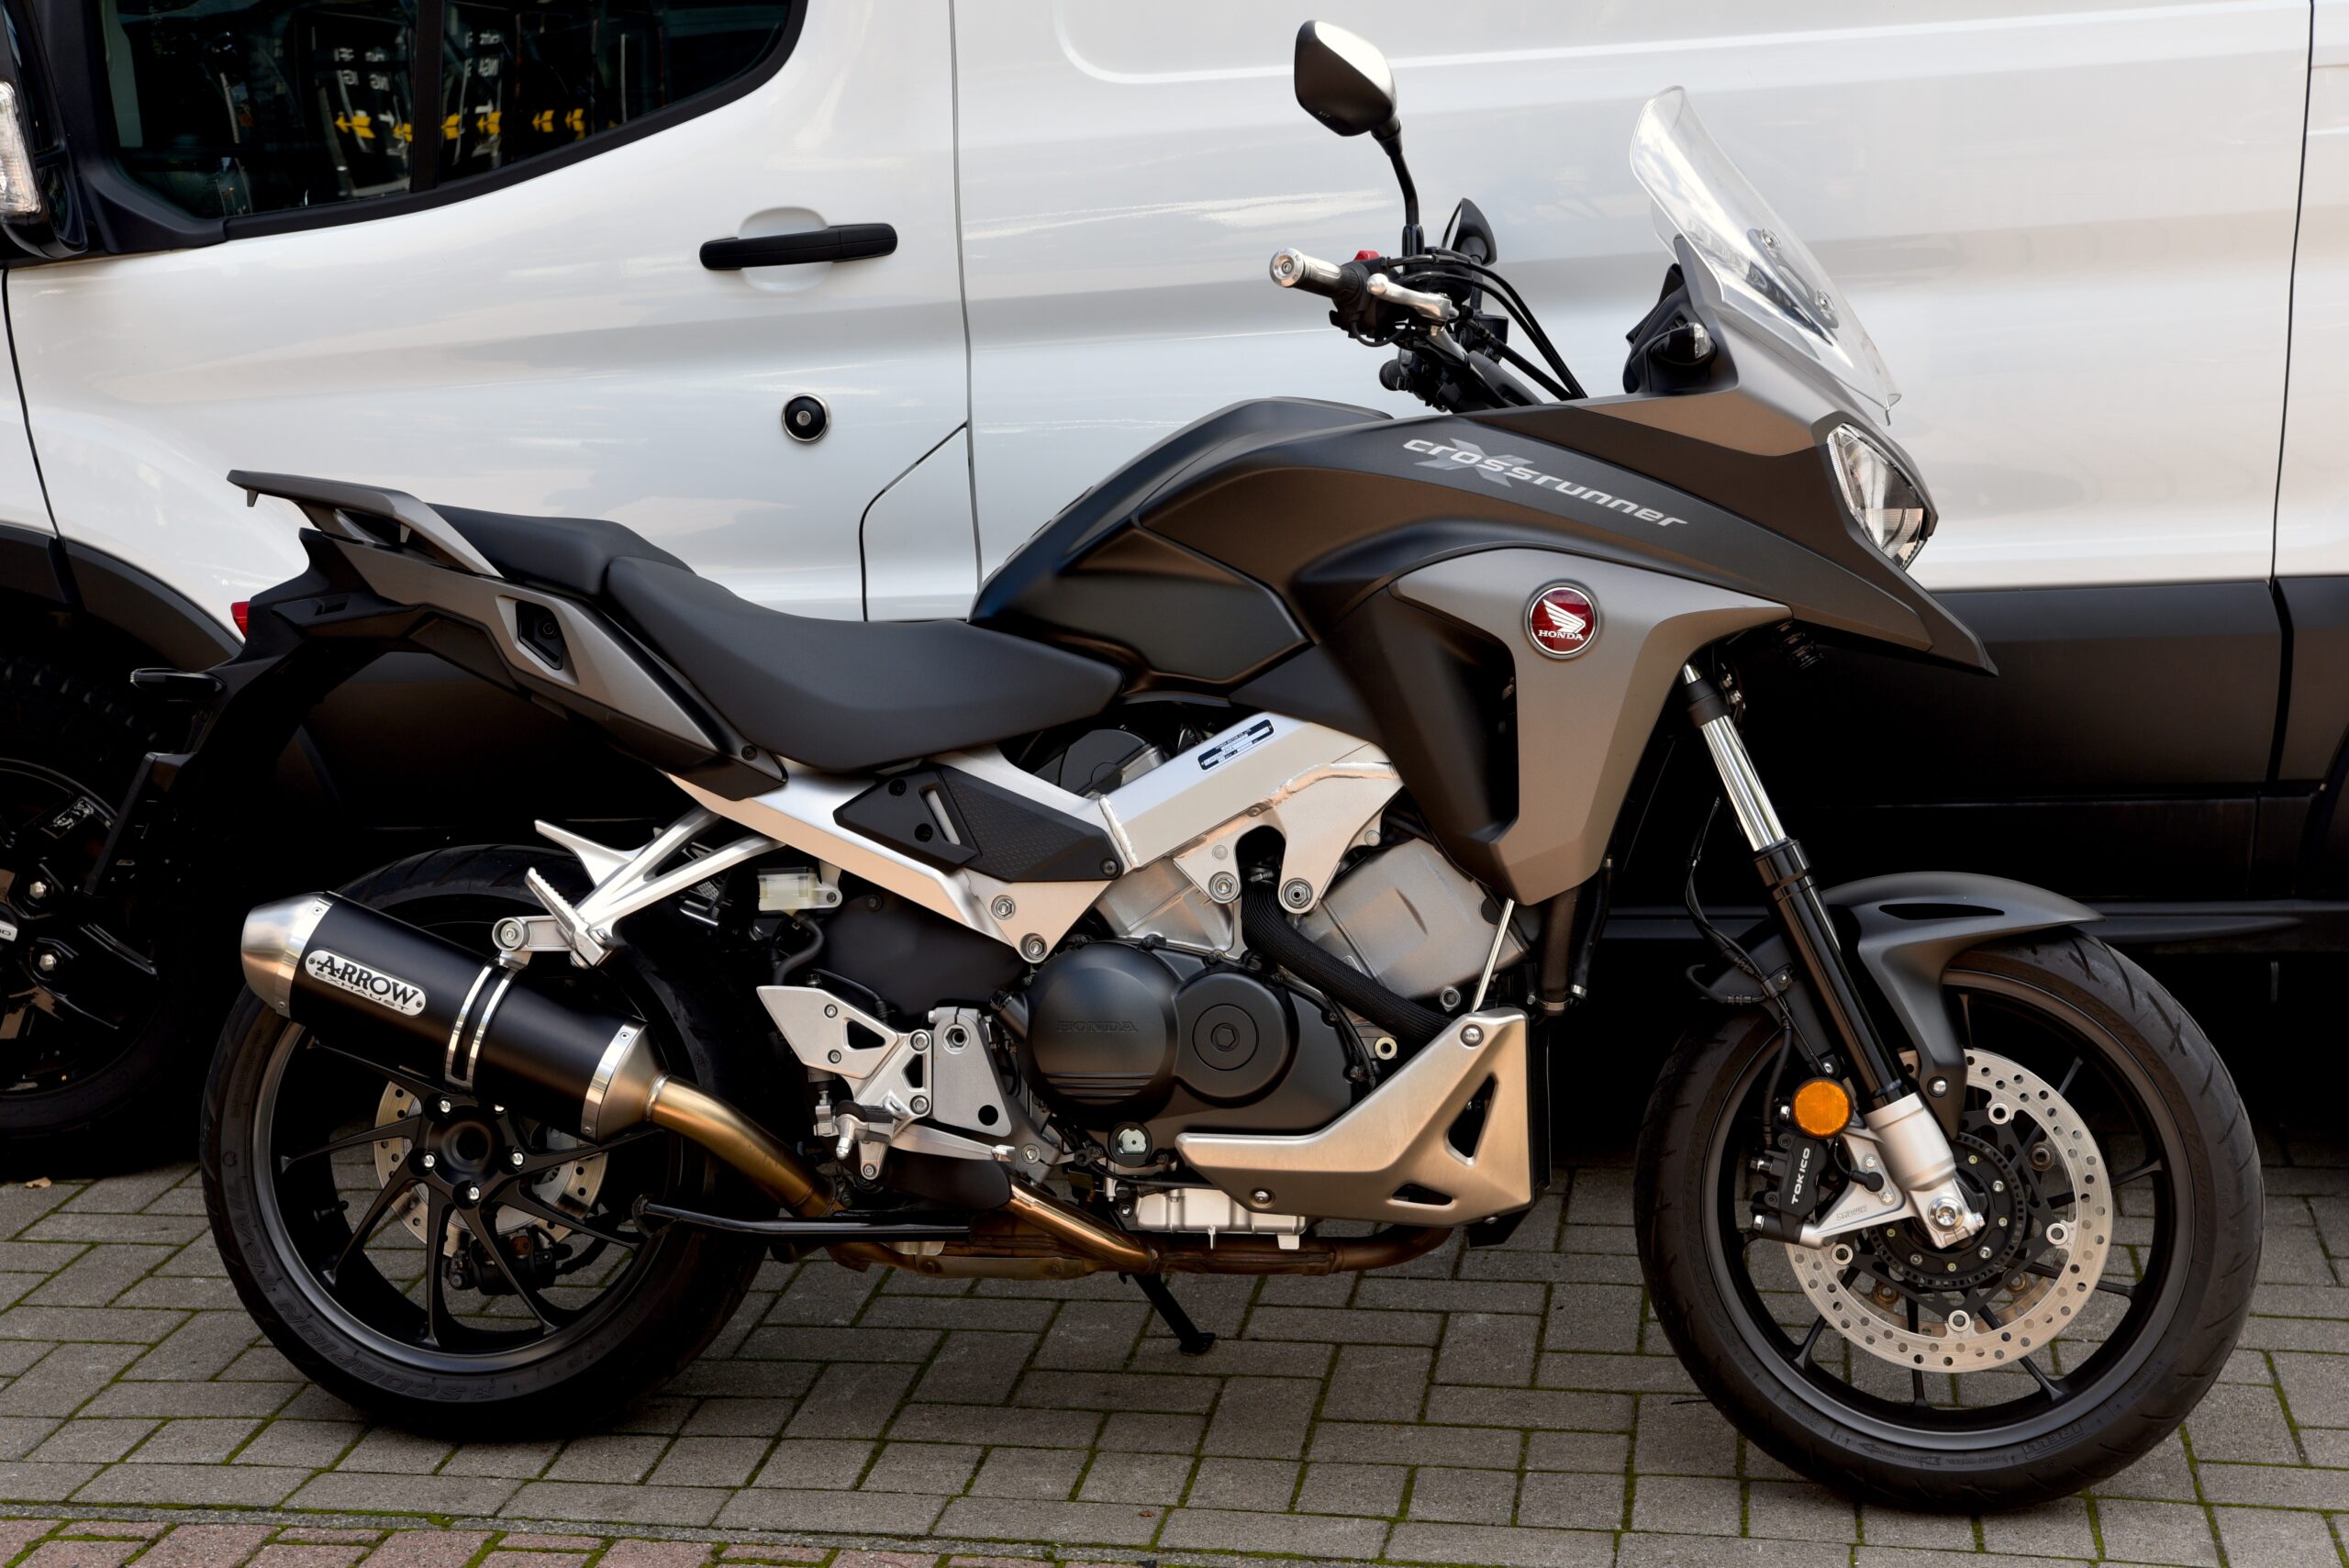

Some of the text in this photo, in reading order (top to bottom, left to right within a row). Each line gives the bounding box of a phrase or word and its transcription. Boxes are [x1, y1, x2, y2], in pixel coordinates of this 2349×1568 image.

[1403, 439, 1688, 527] crossrunner
[1538, 629, 1585, 640] HONDA
[315, 972, 409, 1011] EXHAUST
[317, 955, 419, 1006] ARROW
[1056, 1020, 1139, 1034] HONDA
[1791, 1147, 1811, 1205] TOKICO
[226, 1173, 277, 1293] TRAIL
[277, 1299, 466, 1400] SCORPION
